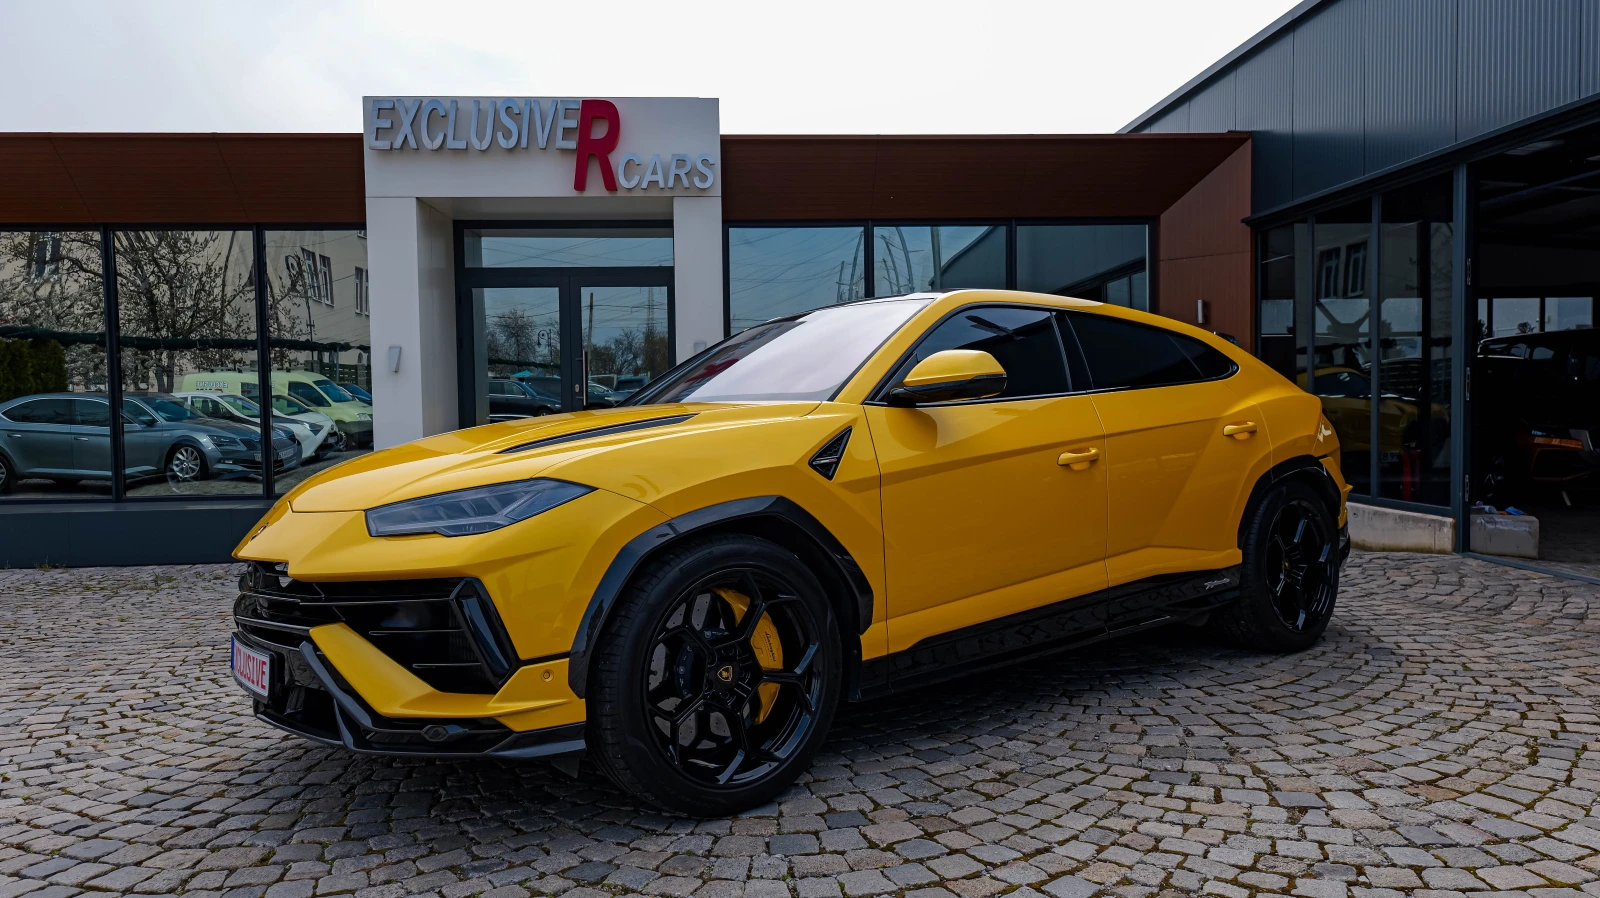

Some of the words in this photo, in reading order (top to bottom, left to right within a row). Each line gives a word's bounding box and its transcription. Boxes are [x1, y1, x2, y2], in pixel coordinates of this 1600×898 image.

[370, 98, 580, 151] EXCLUSIVE
[573, 99, 621, 192] R
[617, 152, 716, 191] CARS
